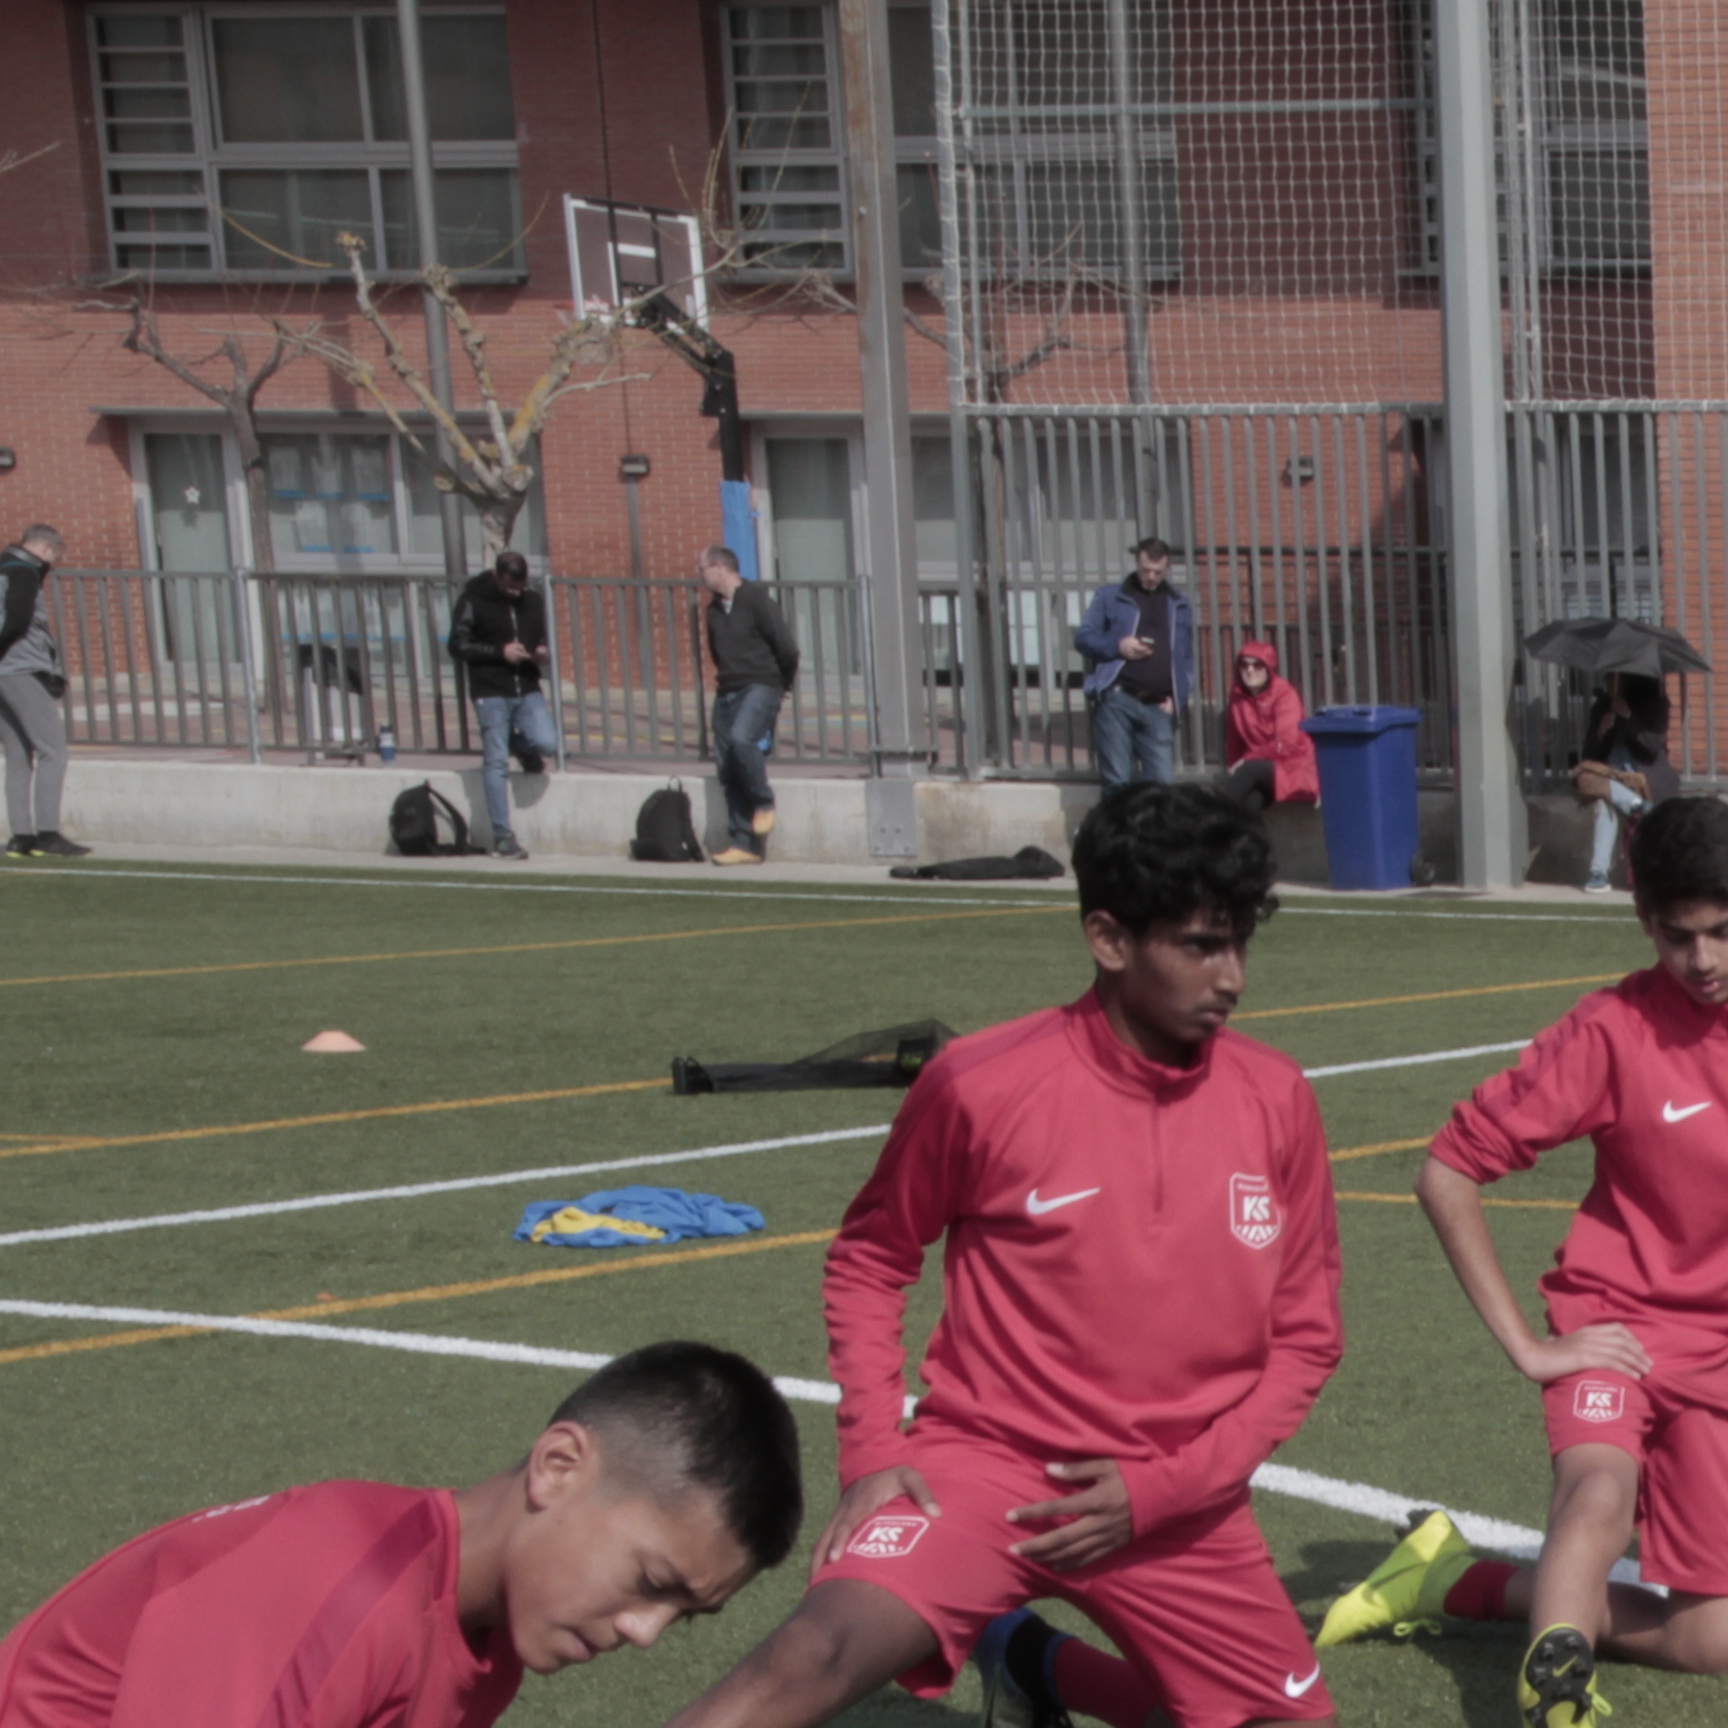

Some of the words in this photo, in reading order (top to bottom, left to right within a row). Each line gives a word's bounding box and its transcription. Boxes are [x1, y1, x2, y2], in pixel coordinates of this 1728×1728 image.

[1242, 1195, 1271, 1222] KS
[1586, 1392, 1612, 1407] KS
[867, 1527, 904, 1542] KS
